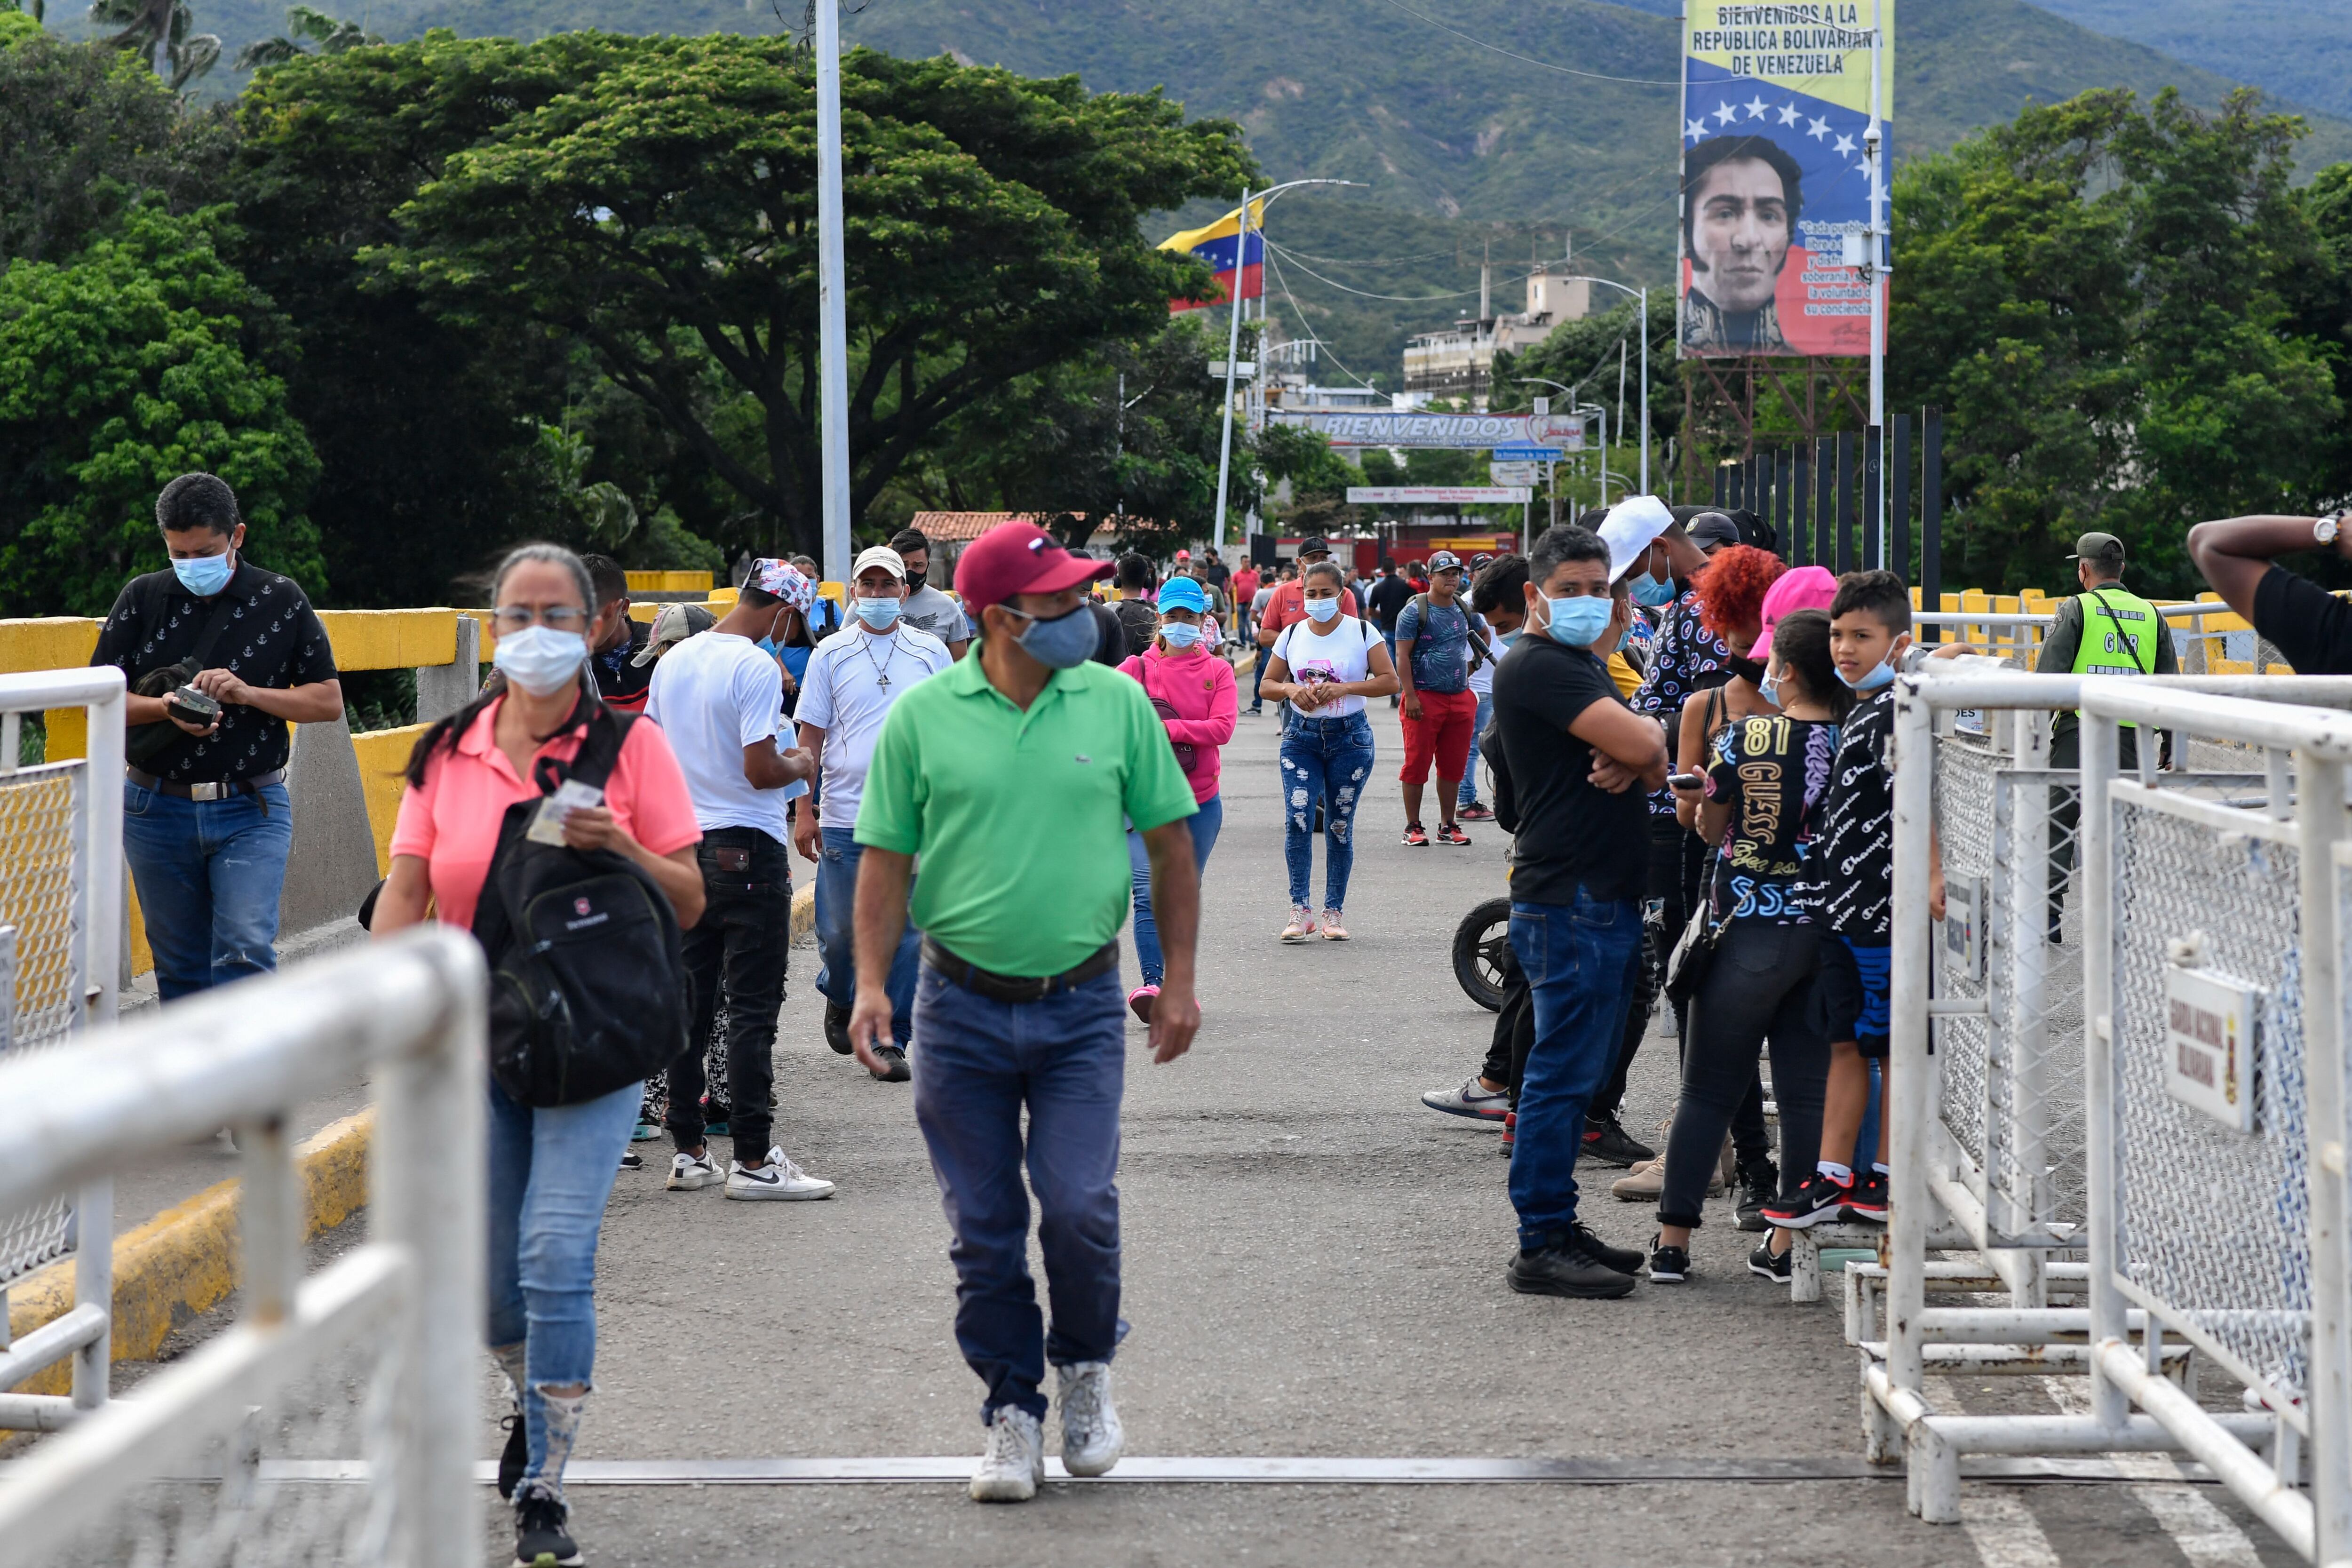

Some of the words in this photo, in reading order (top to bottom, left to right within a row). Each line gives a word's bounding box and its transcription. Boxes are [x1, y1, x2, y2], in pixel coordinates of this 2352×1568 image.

[1719, 4, 1819, 25] BIENVENIDOS
[1825, 4, 1834, 24] A
[1840, 4, 1857, 23] LA
[1733, 56, 1751, 74] DE
[1757, 54, 1843, 74] VENEZUELA
[1821, 286, 1863, 298] voluntad
[1323, 416, 1518, 438] BIENVENIDOS
[2105, 632, 2139, 654] GNB
[1743, 716, 1791, 756] 81
[1738, 762, 1782, 844] GUESS
